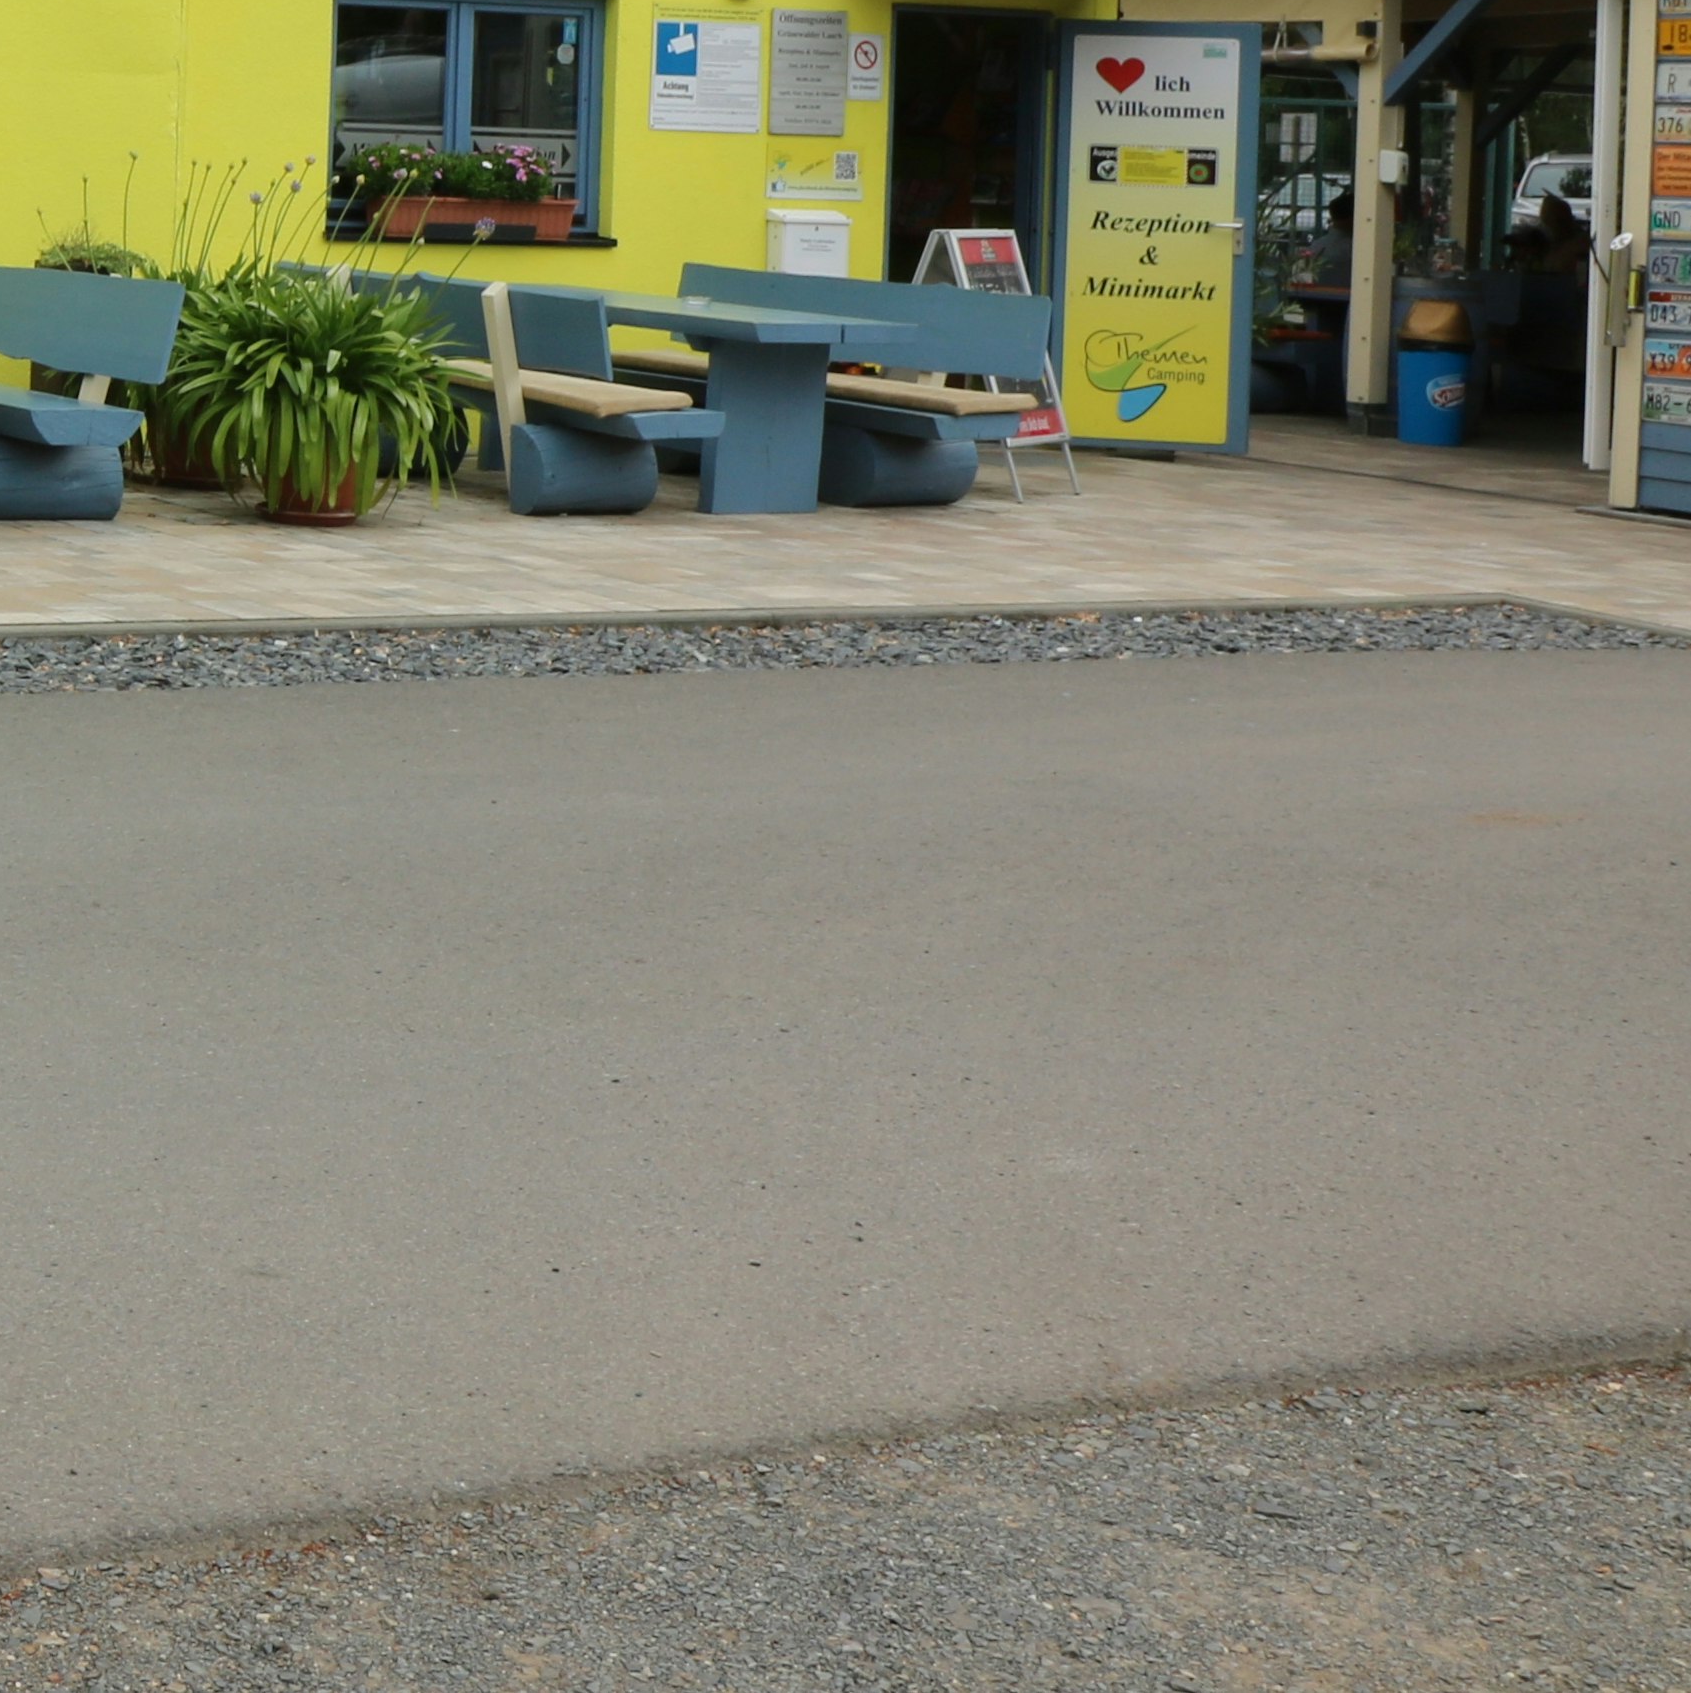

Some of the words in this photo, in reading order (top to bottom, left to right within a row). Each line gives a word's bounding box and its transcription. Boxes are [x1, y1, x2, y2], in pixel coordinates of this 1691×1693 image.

[779, 13, 842, 26] Öffnungszeiten
[662, 81, 689, 92] Achtung
[1154, 74, 1192, 93] lich
[1095, 99, 1226, 120] Willkommen
[1657, 117, 1684, 134] 376
[1090, 210, 1211, 238] Rezeption
[1653, 209, 1681, 229] GND
[1138, 246, 1159, 267] &
[1651, 256, 1679, 277] 657
[1082, 276, 1217, 302] Minimarkt
[1100, 330, 1208, 365] Themen
[1146, 367, 1206, 385] Camping
